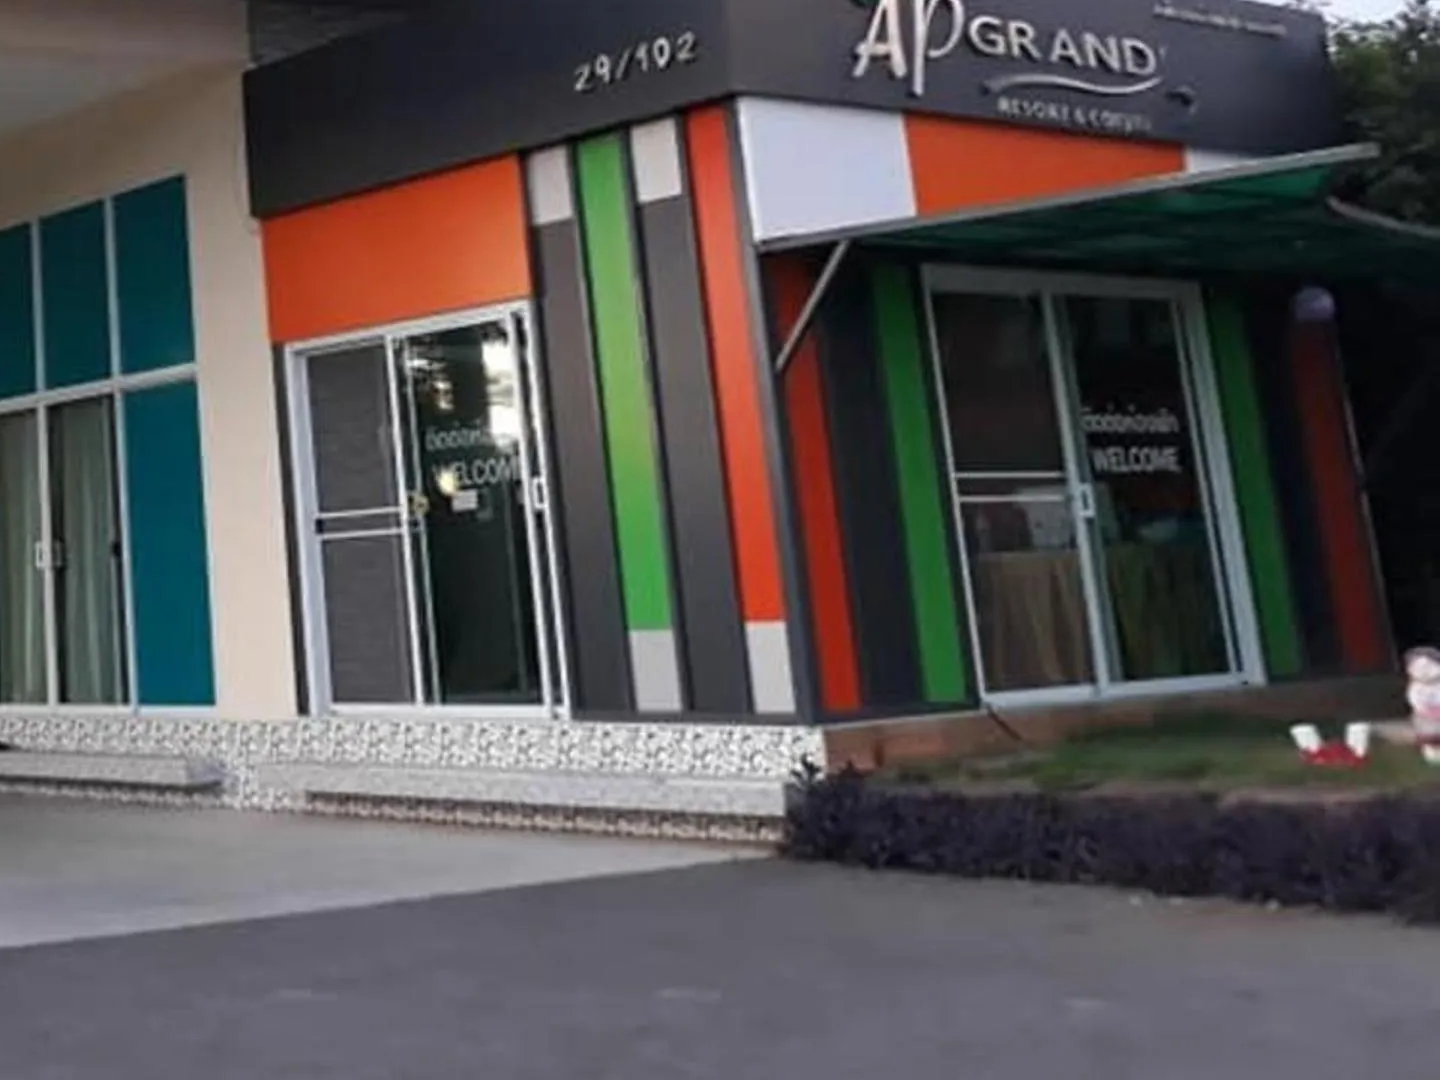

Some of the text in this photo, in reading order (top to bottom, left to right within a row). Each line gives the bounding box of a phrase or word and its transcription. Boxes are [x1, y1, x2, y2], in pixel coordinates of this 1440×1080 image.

[574, 30, 696, 92] 29/102
[967, 15, 1157, 76] GRAND
[1092, 445, 1182, 474] WELCOME
